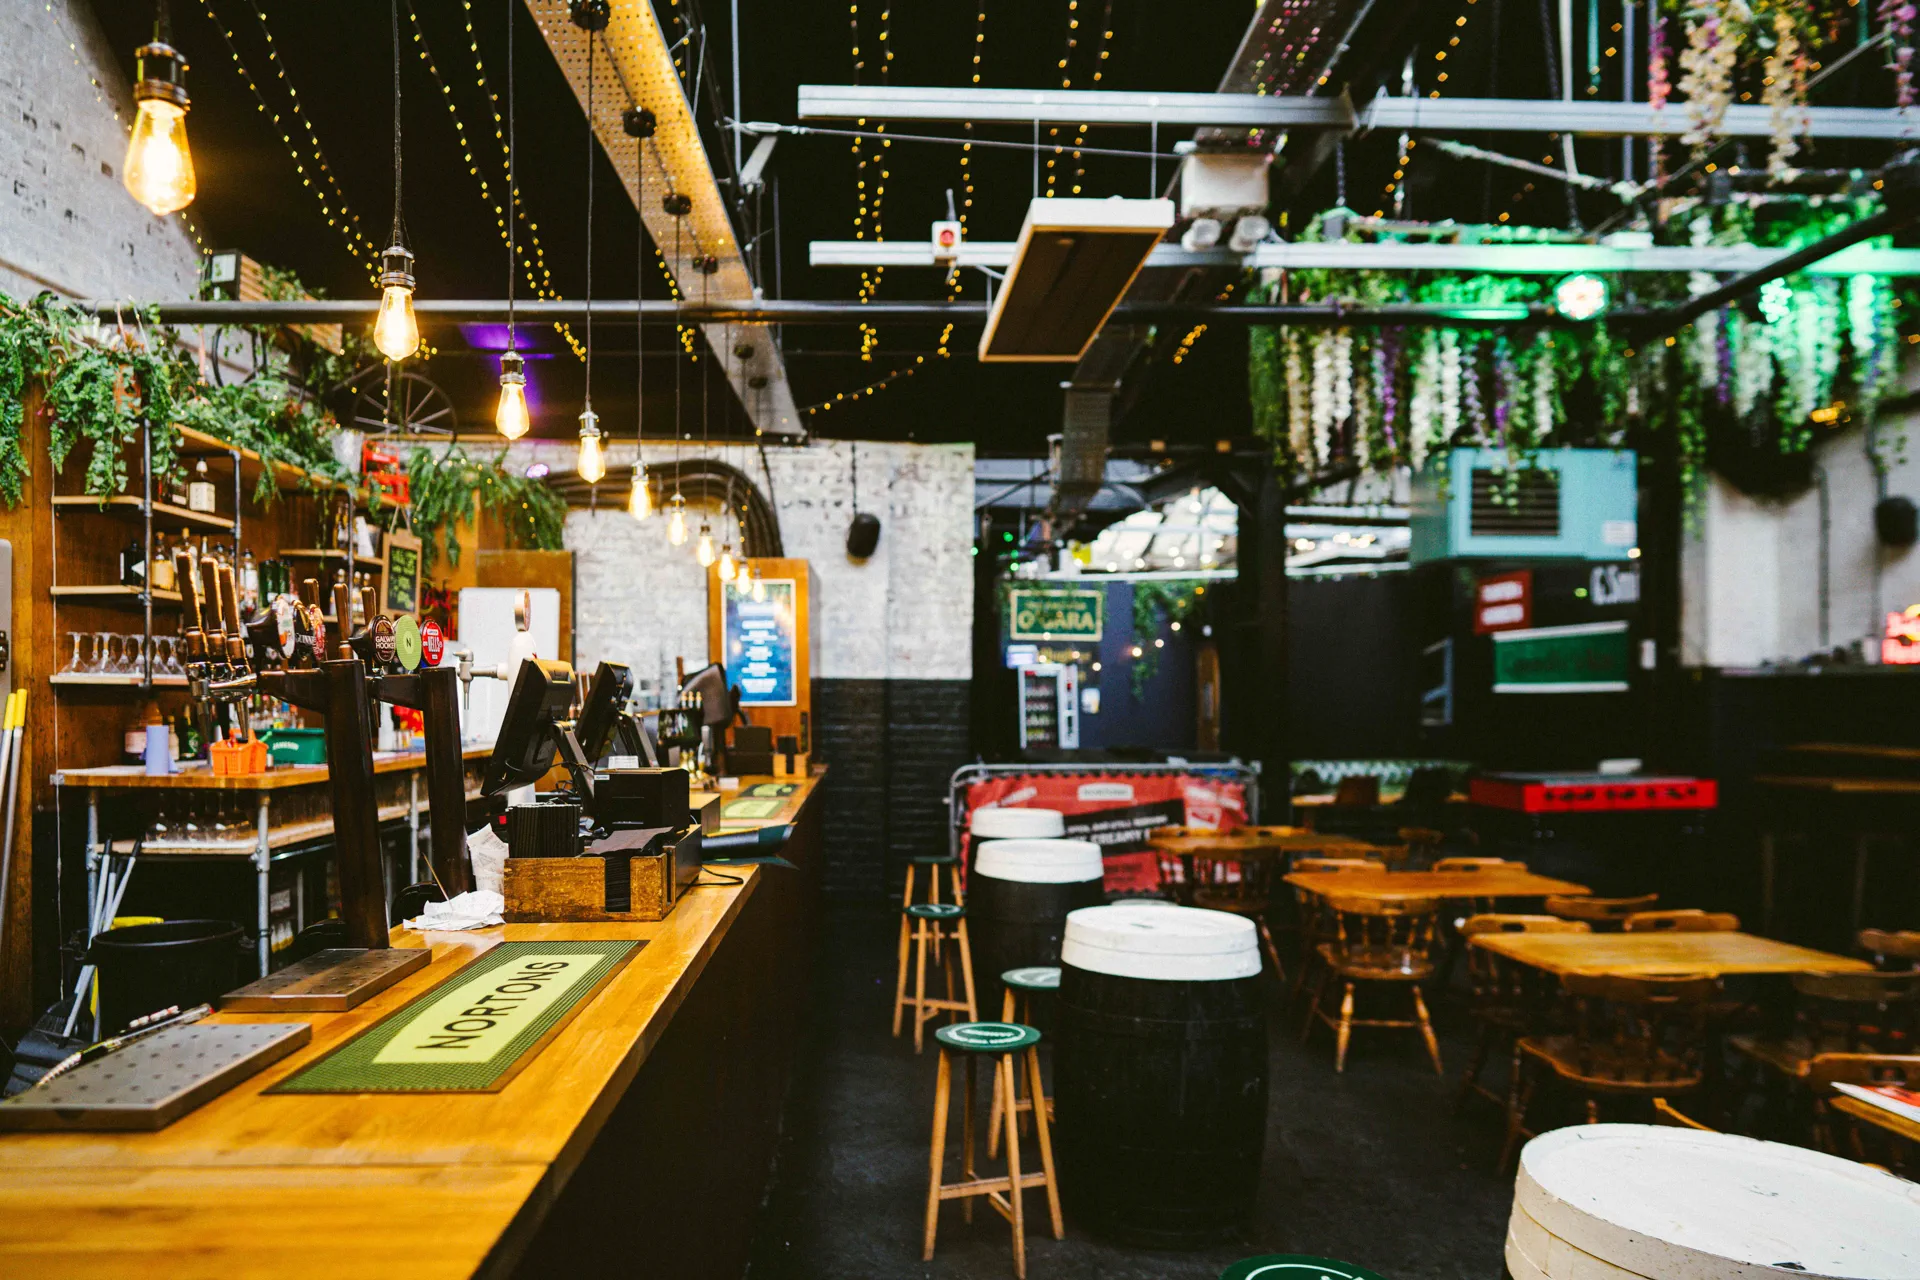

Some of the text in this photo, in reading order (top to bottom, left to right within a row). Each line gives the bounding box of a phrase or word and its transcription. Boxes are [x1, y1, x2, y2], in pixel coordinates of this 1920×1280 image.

[375, 635, 395, 643] GALWA
[406, 638, 412, 647] N
[416, 960, 569, 1050] NORTONS
